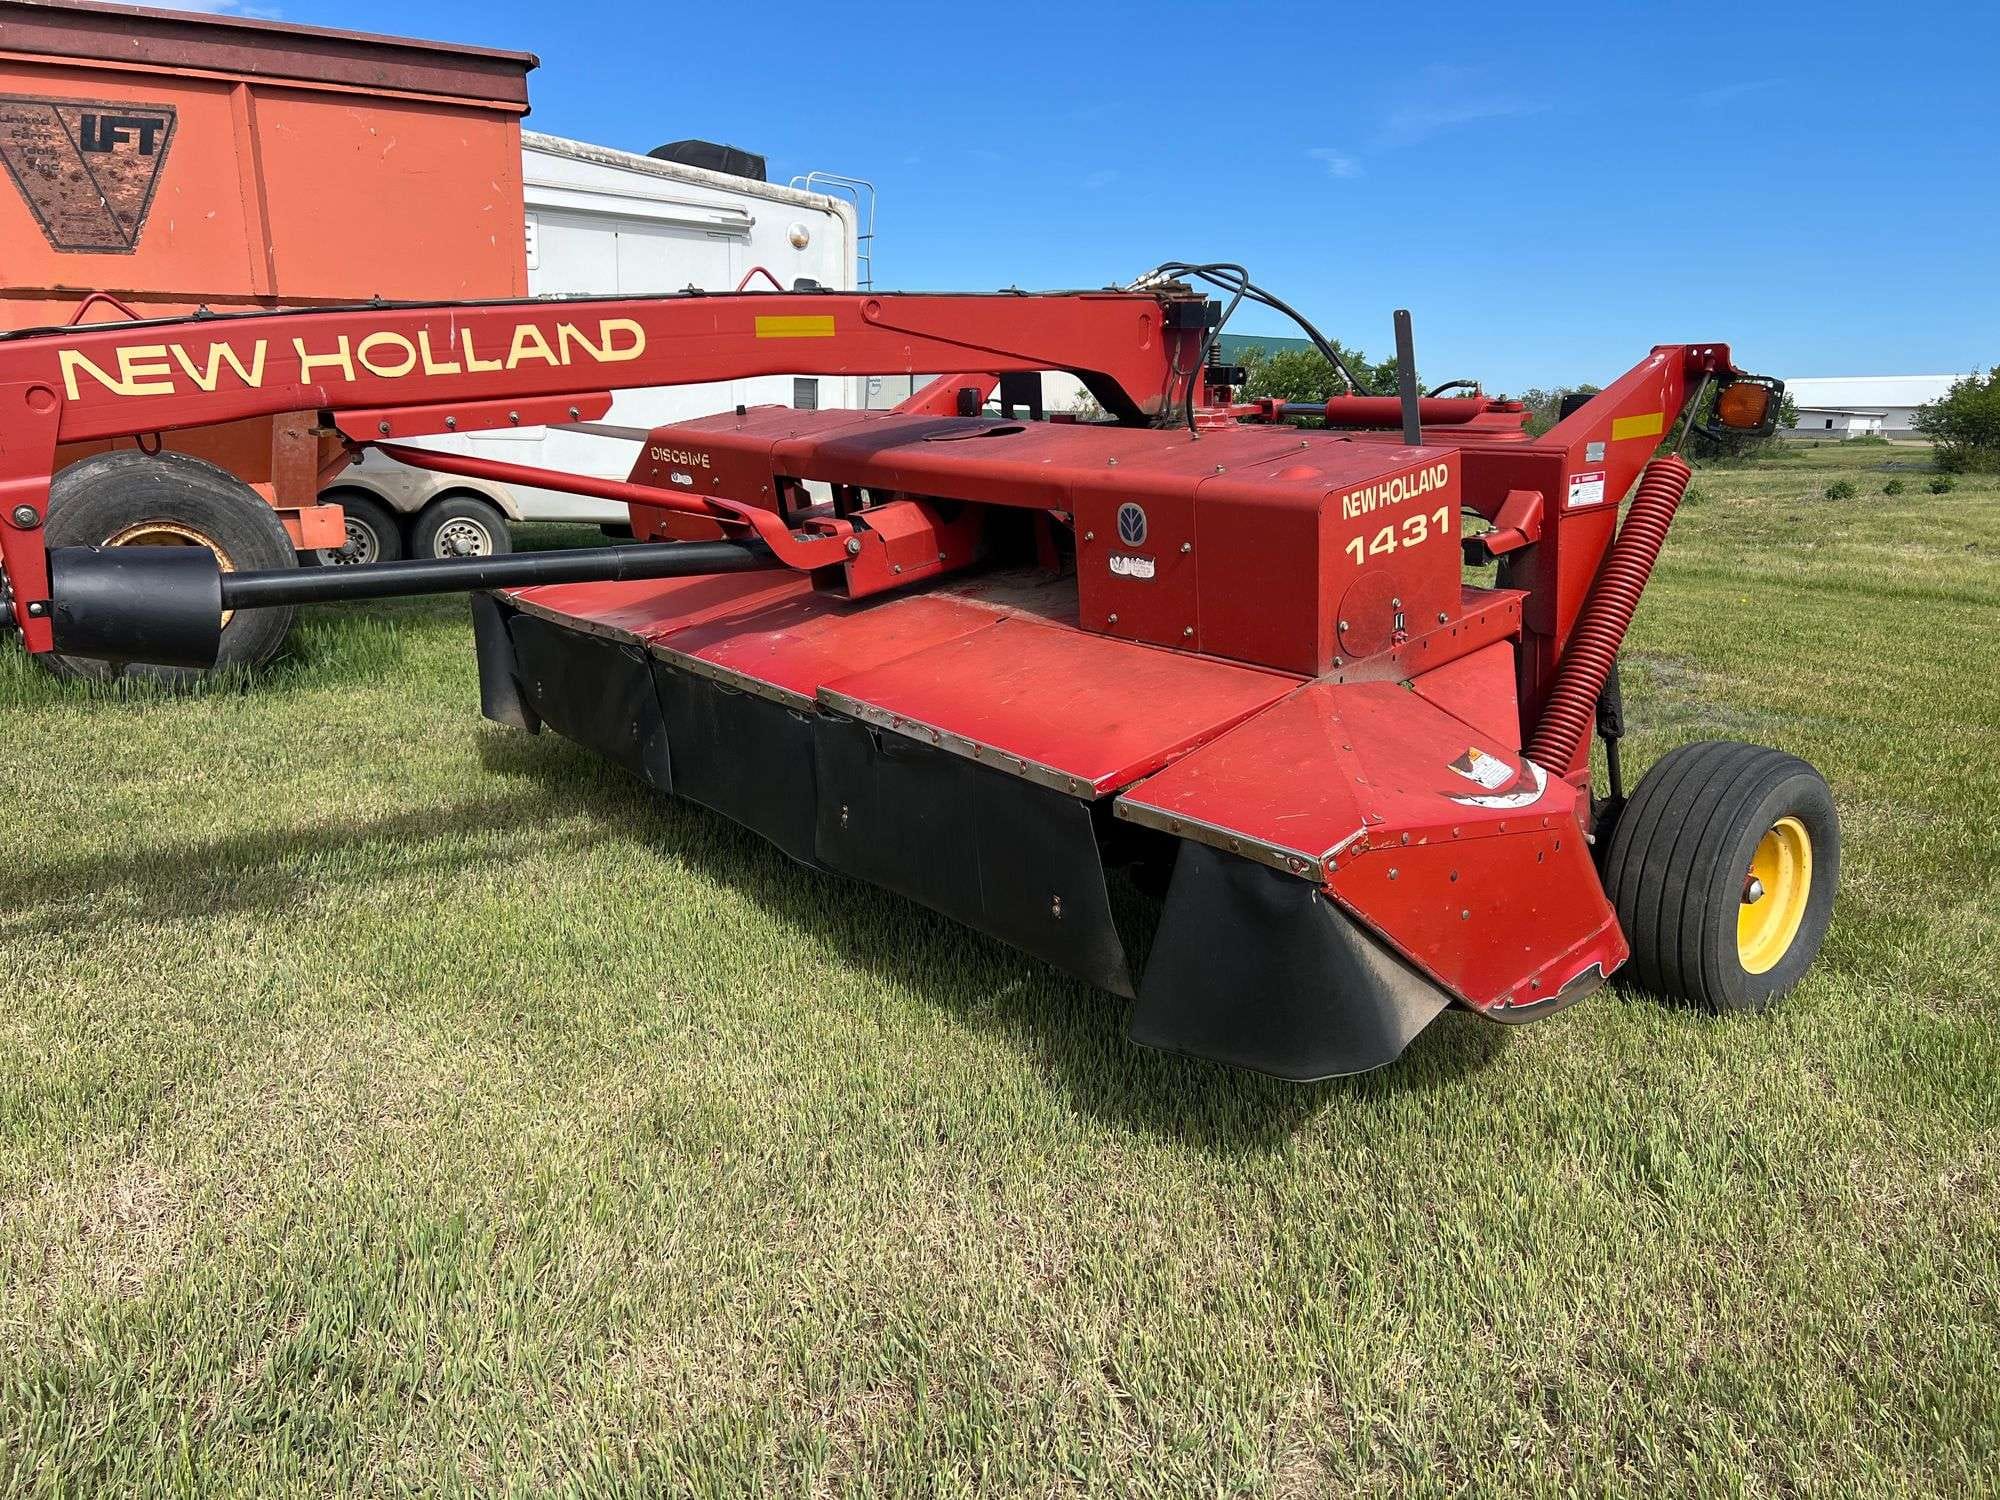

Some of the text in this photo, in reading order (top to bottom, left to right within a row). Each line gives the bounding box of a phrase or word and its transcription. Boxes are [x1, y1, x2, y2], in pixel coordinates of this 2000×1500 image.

[80, 113, 164, 156] UFT
[58, 318, 646, 401] NEW HOLLAND
[650, 446, 711, 469] DISCBINE
[1342, 463, 1449, 521] NEW HOLLAND
[1344, 505, 1450, 566] 1431
